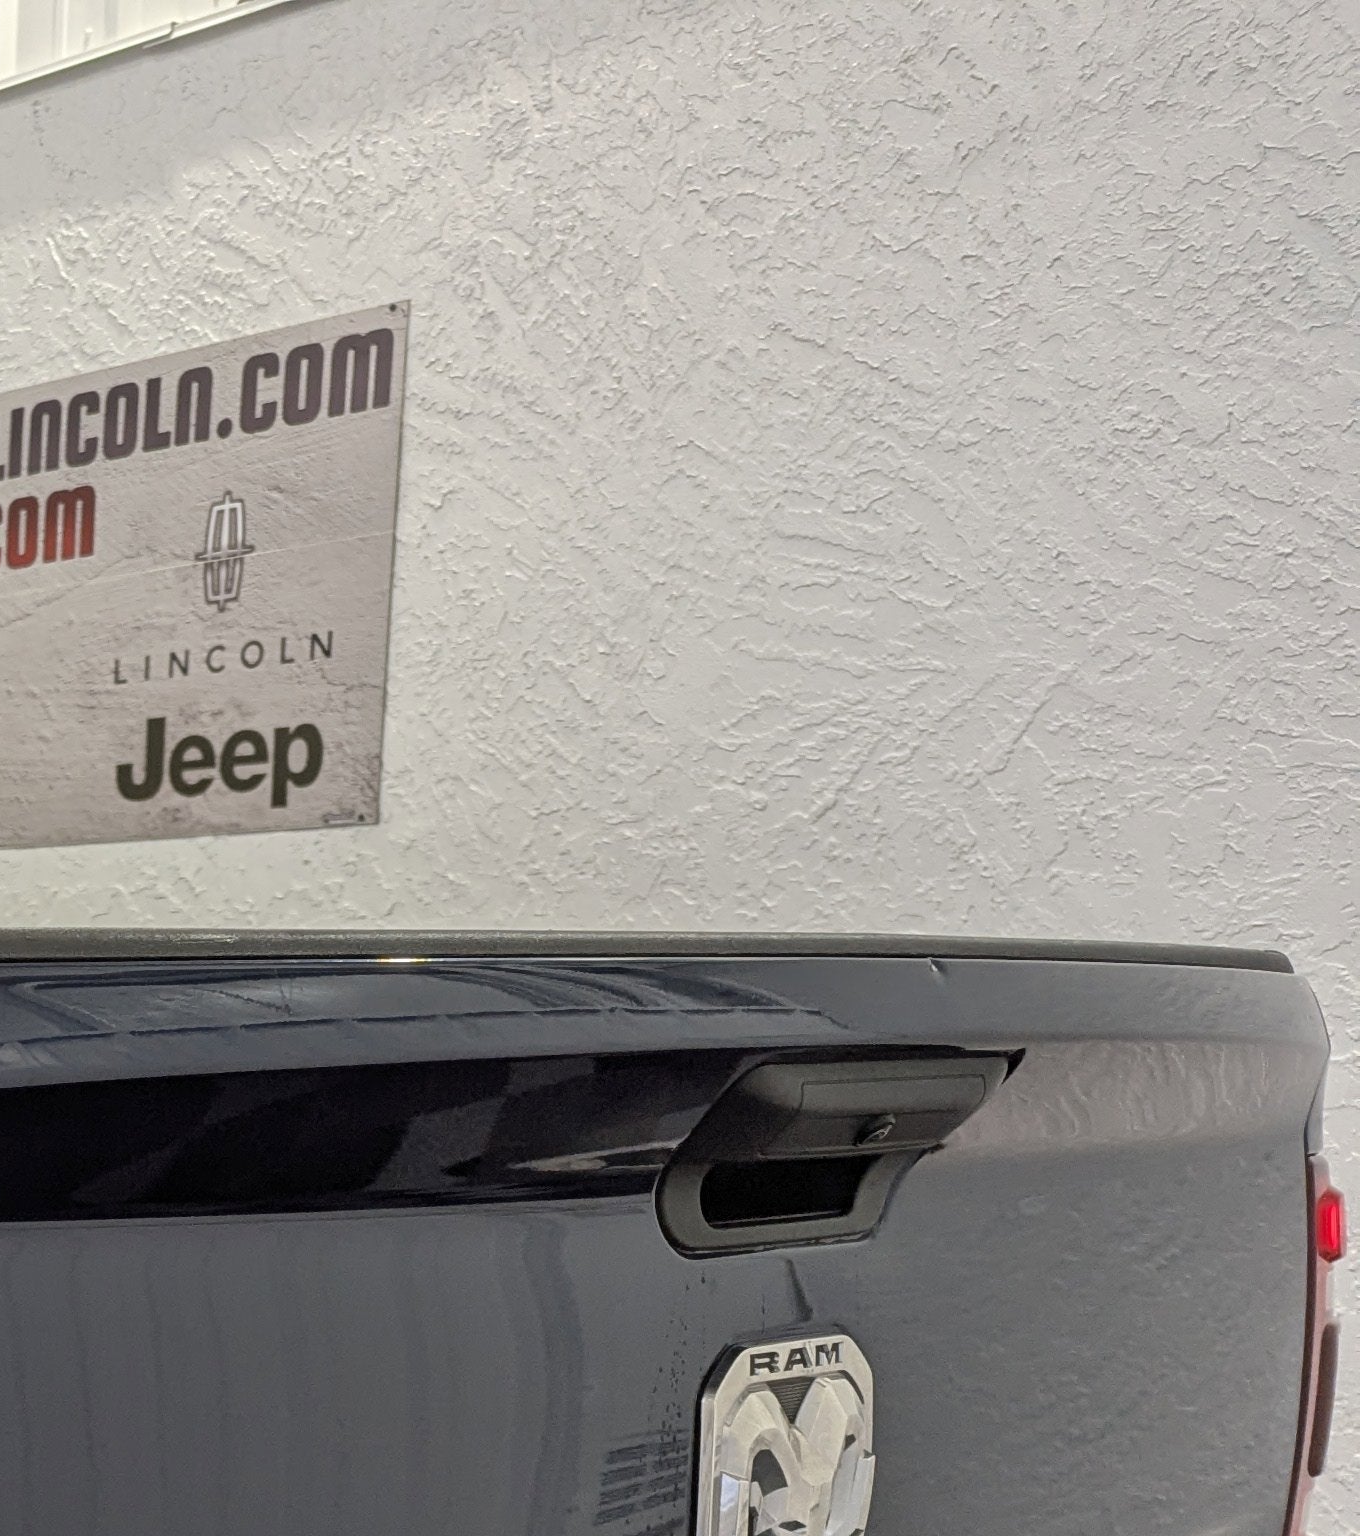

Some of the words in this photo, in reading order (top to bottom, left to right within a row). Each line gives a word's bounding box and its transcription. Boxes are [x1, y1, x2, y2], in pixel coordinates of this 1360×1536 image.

[113, 630, 333, 684] LINCOLN
[116, 716, 324, 809] Jeep
[748, 1341, 844, 1377] RAM
